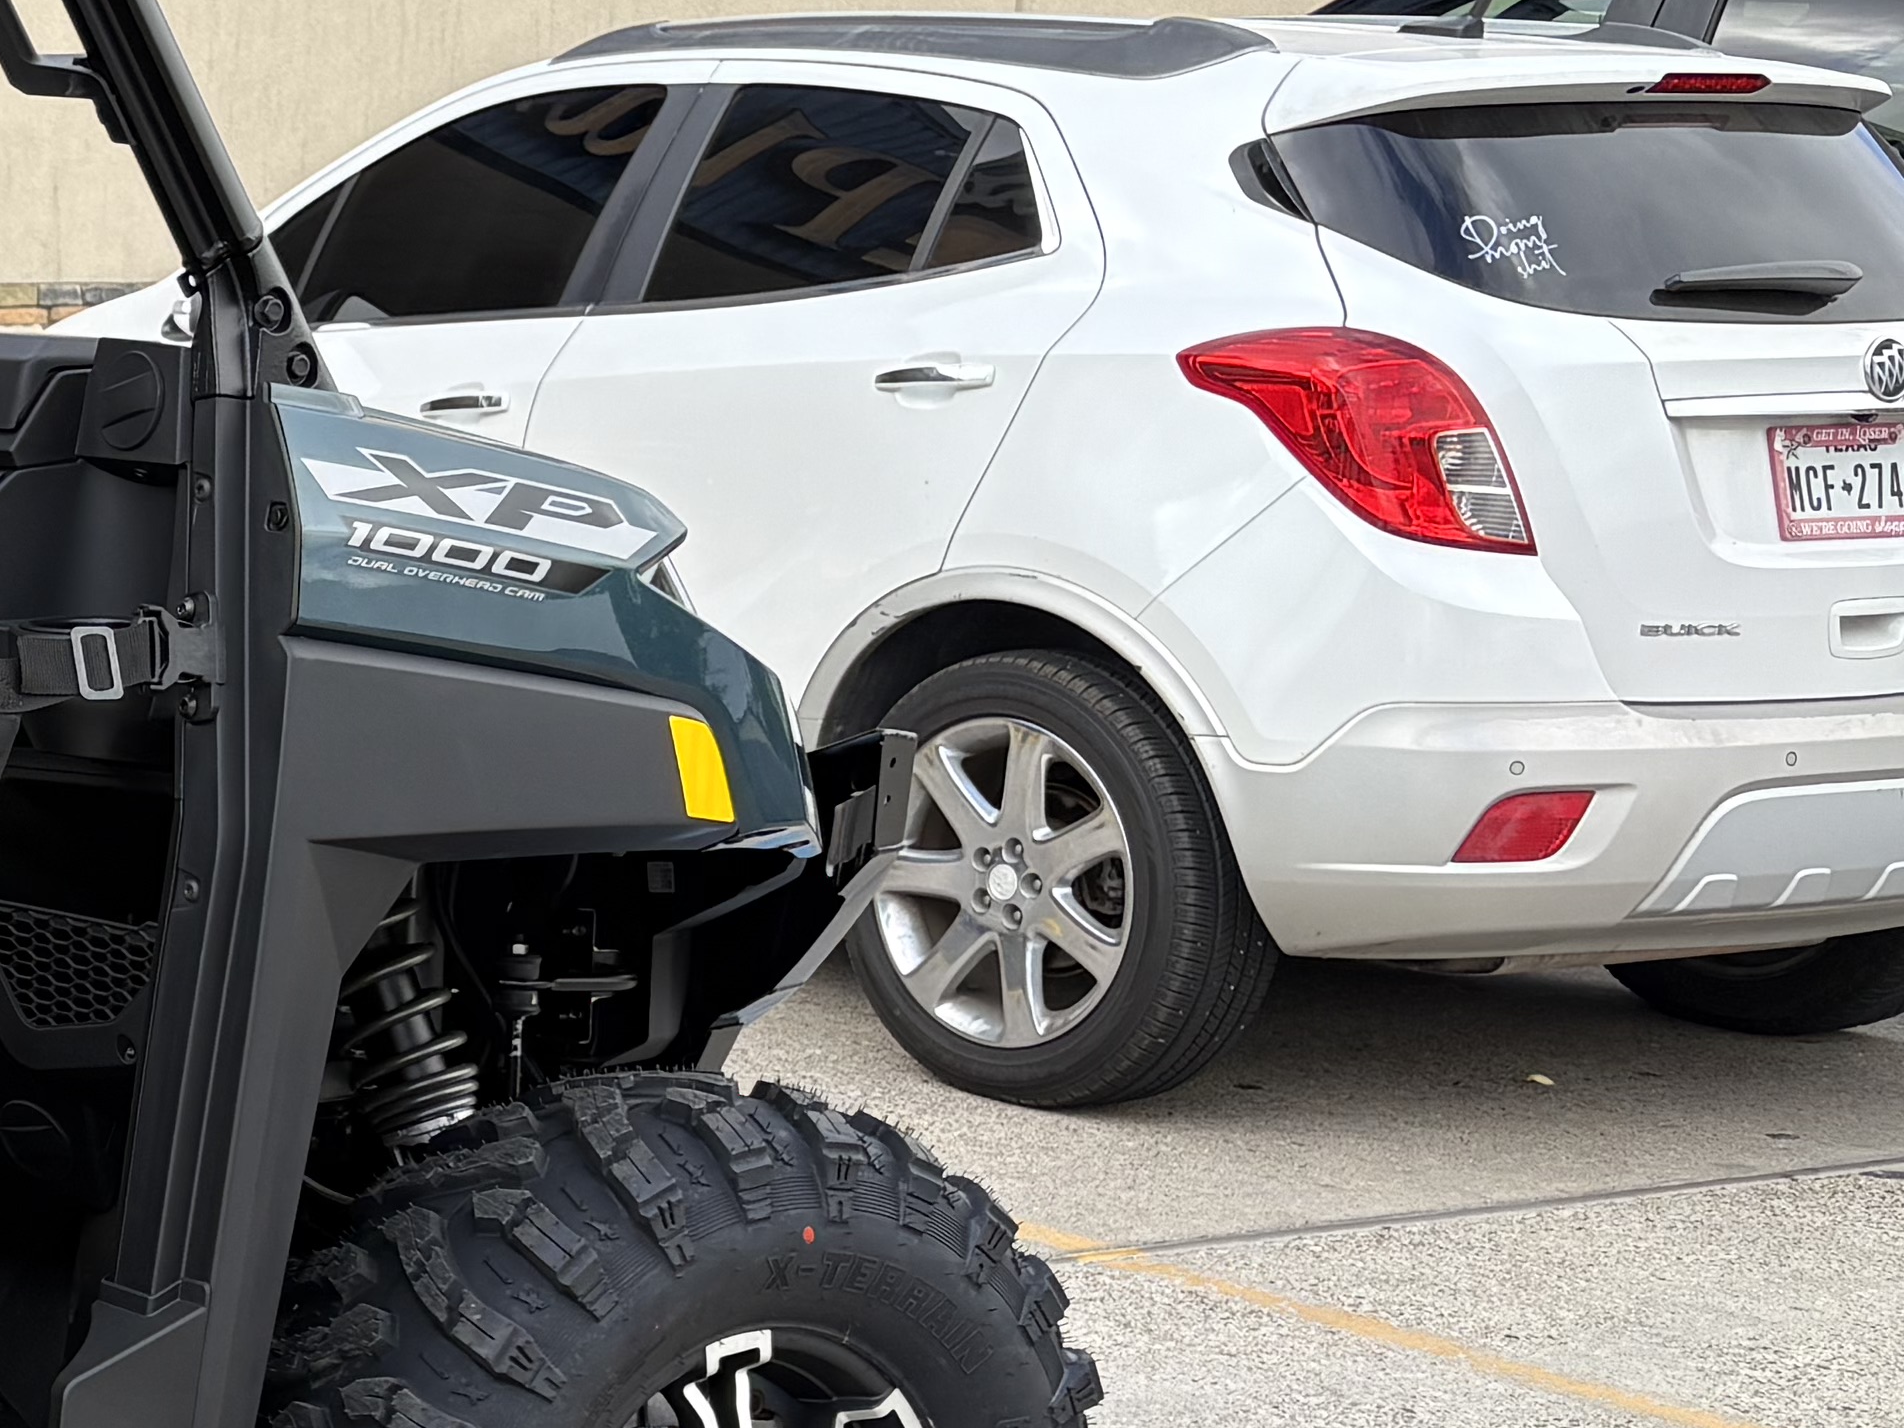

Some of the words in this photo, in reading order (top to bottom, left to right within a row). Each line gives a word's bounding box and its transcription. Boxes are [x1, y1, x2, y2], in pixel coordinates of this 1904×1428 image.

[1460, 215, 1548, 261] Doing
[1813, 429, 1835, 441] GET
[1855, 425, 1889, 445] LOSER
[322, 447, 637, 540] XP
[1837, 520, 1872, 534] GOING
[347, 521, 552, 583] 1000
[347, 556, 398, 574] DUAL
[403, 566, 503, 593] OVERHEAD
[504, 585, 546, 603] CAM
[1639, 623, 1742, 637] BUICK
[763, 1250, 994, 1374] X-TERRAIN
